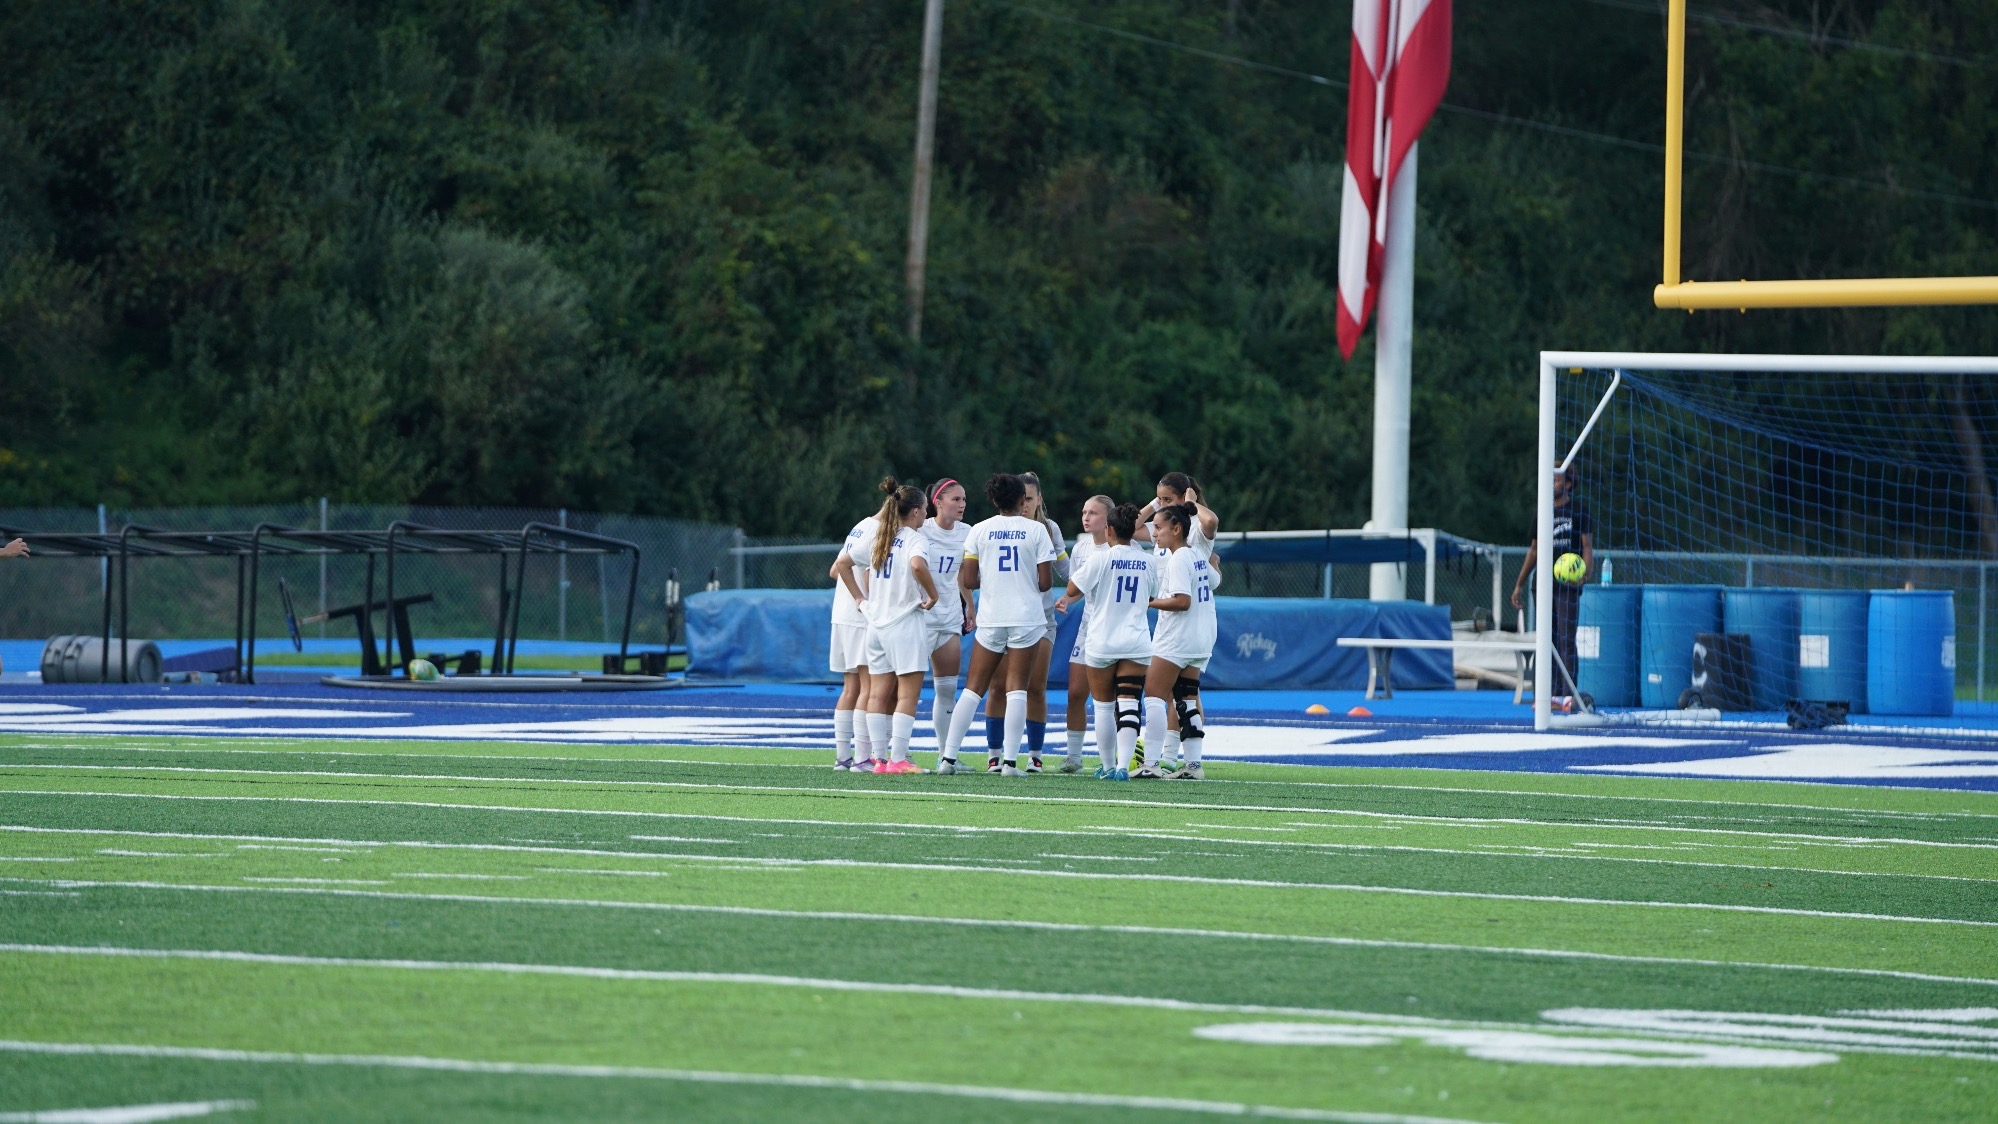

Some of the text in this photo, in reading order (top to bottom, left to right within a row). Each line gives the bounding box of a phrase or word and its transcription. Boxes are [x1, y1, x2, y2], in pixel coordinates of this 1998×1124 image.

[988, 530, 1027, 541] PIONEERS
[875, 552, 894, 579] 0
[938, 555, 955, 574] 17
[998, 545, 1019, 572] 21
[1111, 559, 1147, 571] PIONEERS
[1115, 575, 1140, 604] 14
